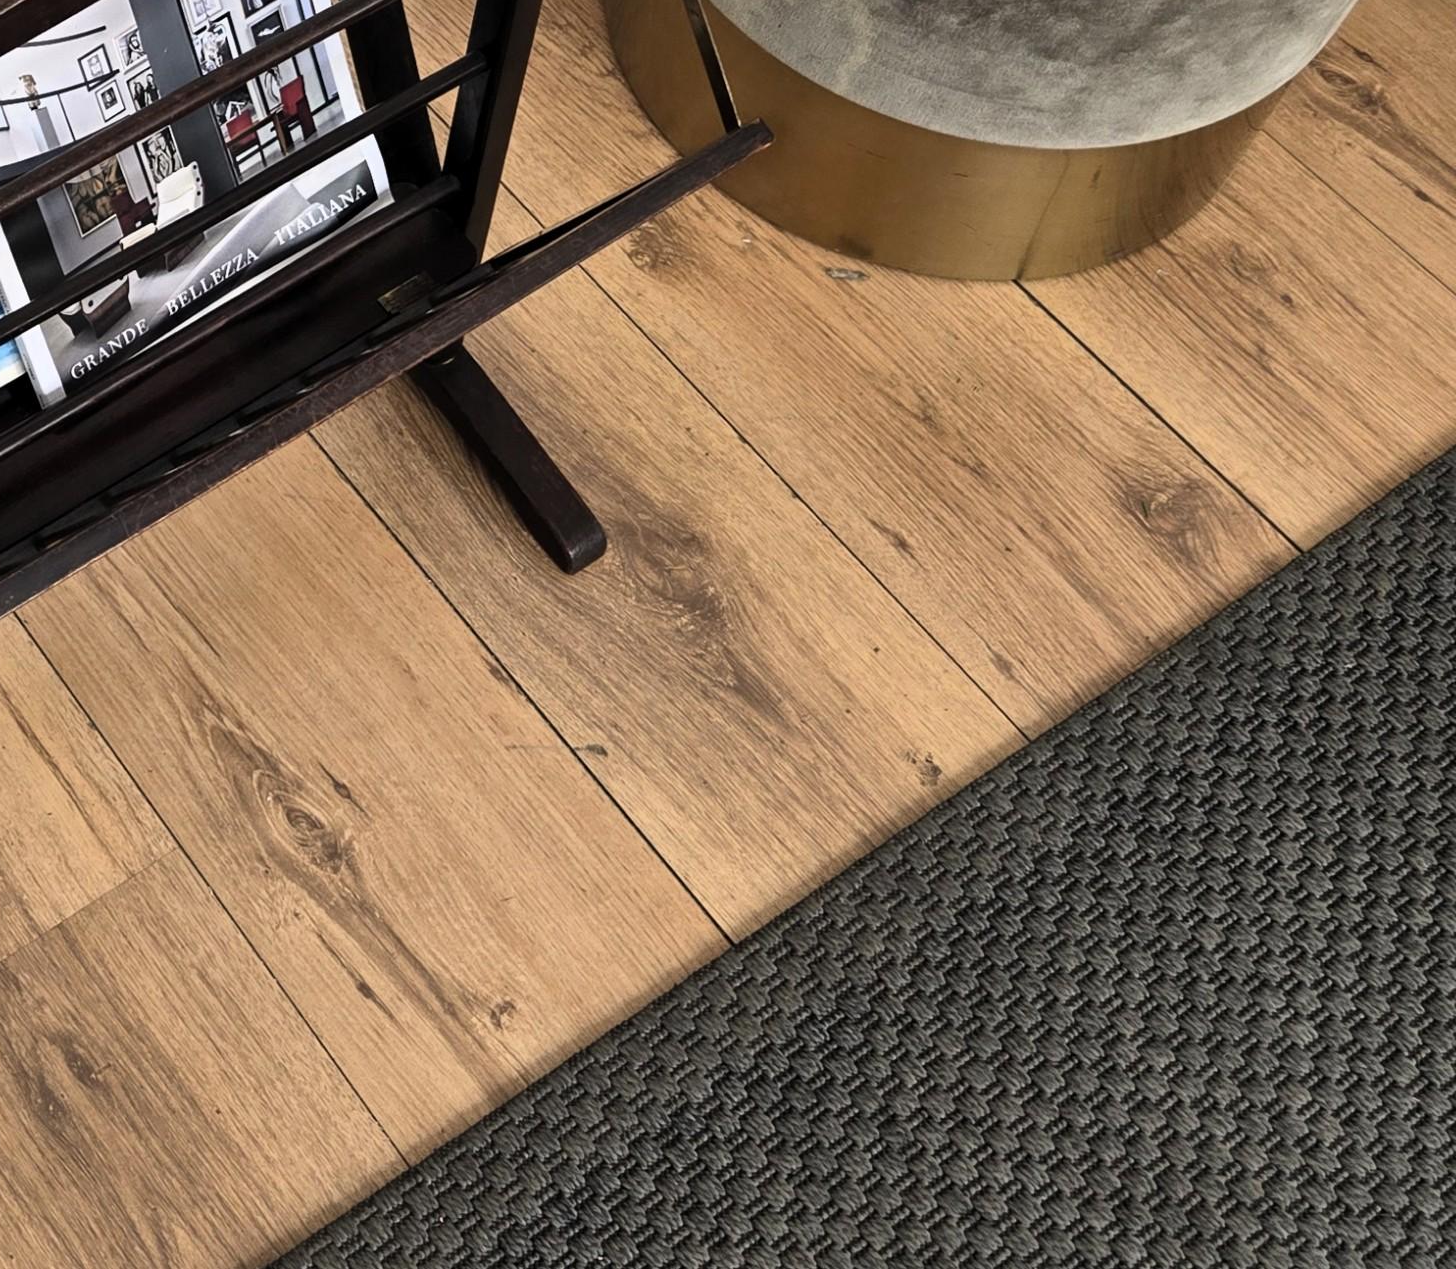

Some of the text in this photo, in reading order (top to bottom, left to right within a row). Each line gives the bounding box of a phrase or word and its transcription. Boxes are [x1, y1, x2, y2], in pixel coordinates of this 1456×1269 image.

[70, 319, 150, 380] GRANDE
[166, 248, 259, 316] BELLEZZA
[274, 183, 367, 246] ITALIANA
